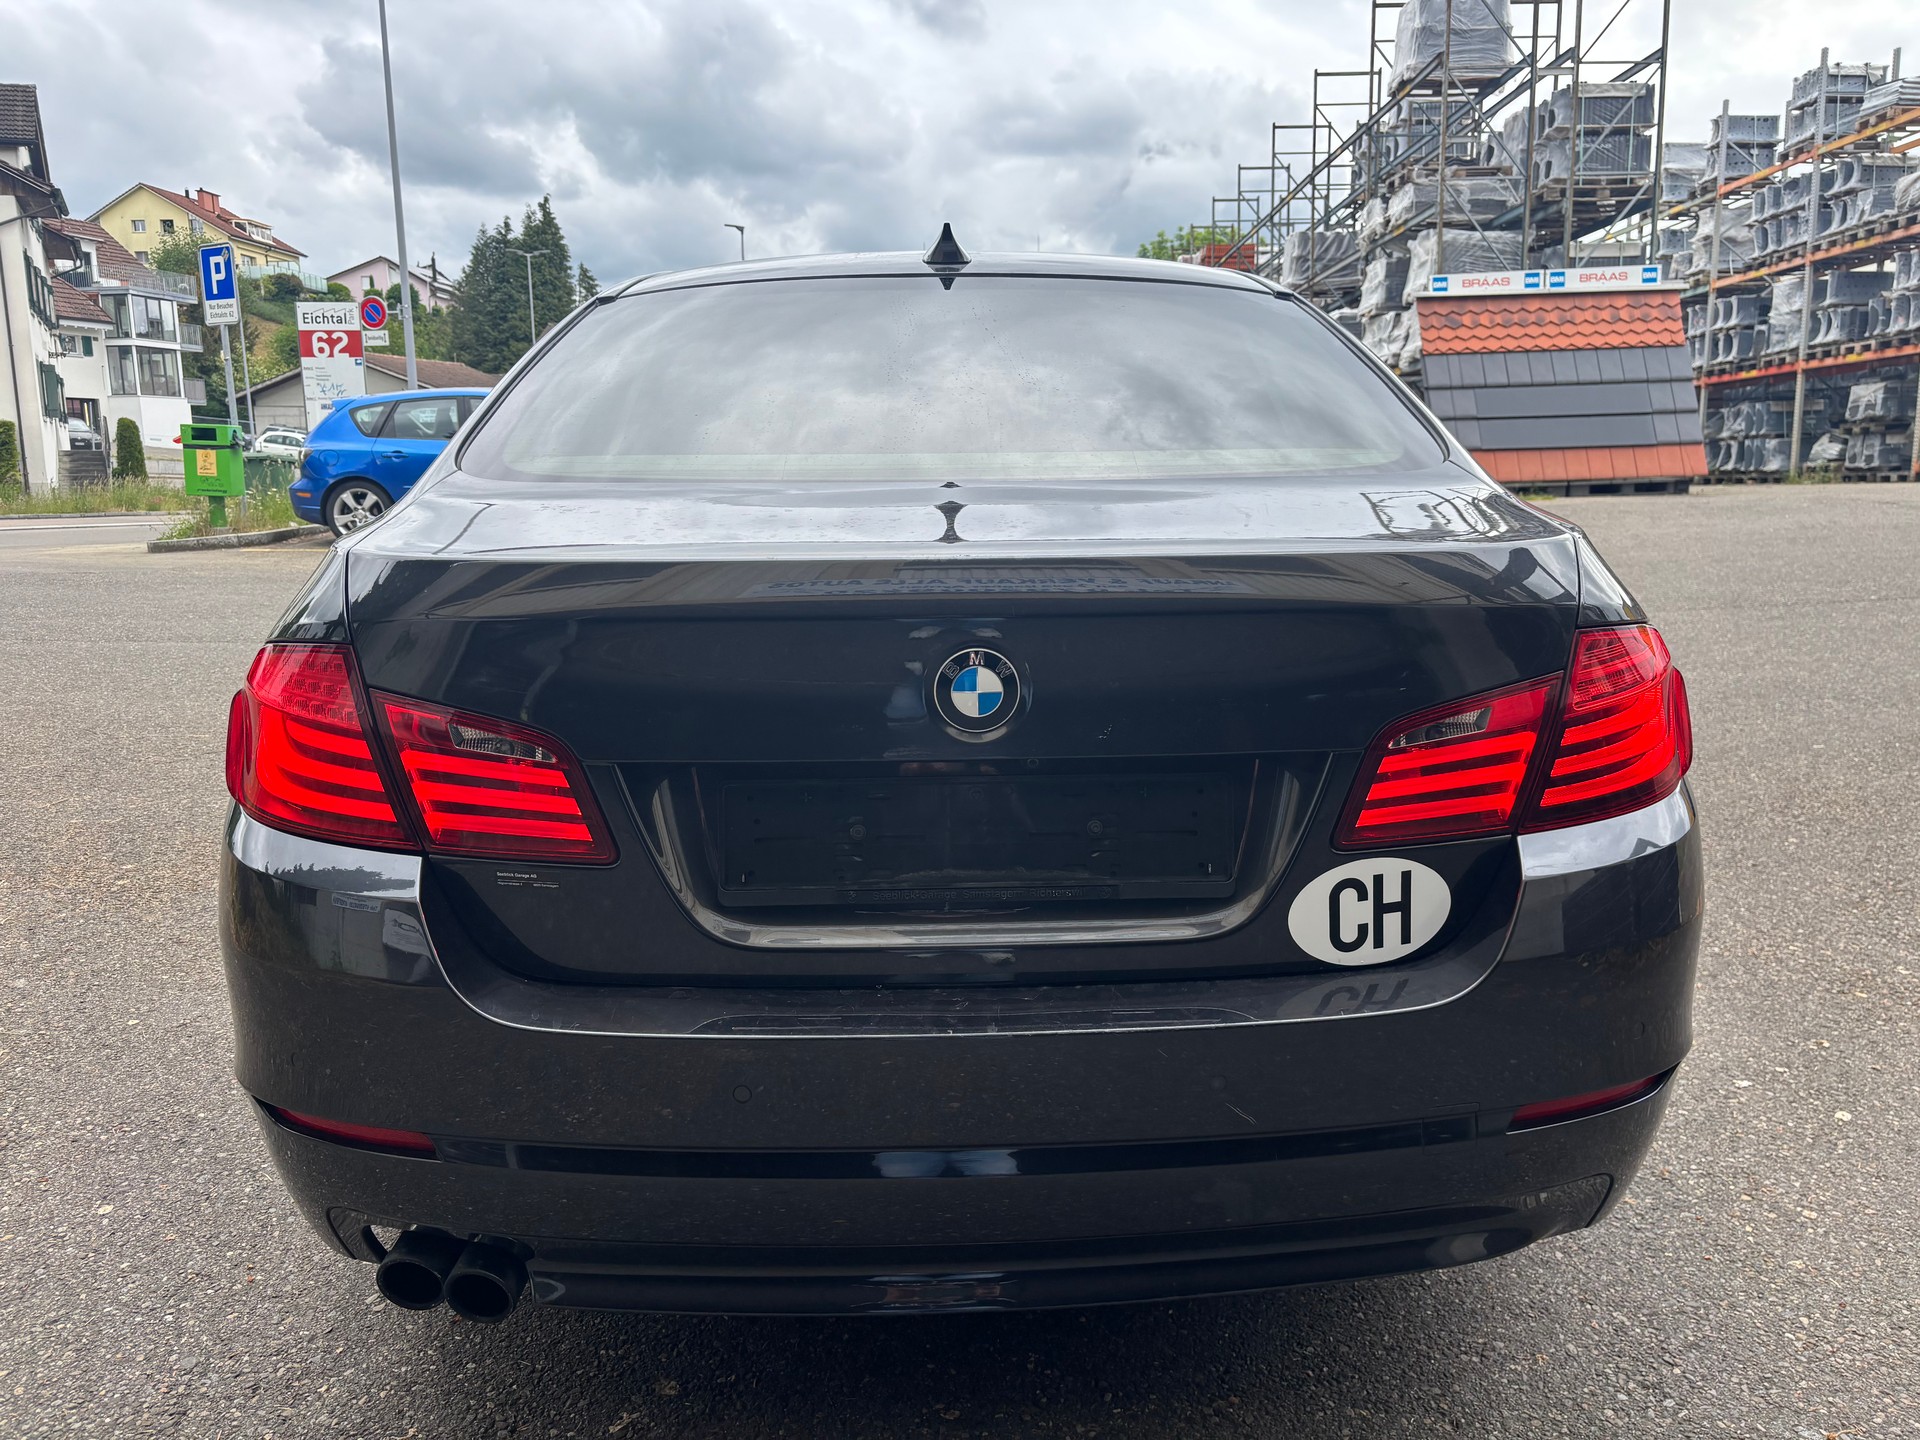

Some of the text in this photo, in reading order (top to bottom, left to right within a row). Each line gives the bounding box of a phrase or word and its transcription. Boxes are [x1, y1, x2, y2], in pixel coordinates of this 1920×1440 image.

[209, 255, 226, 295] P
[1462, 276, 1510, 288] BRAAS
[1579, 271, 1628, 283] BRAAS
[216, 302, 234, 310] Besucher
[228, 310, 234, 318] 62
[302, 311, 347, 325] Eichtal
[311, 331, 350, 358] 62
[943, 651, 1013, 680] BMW
[1329, 870, 1412, 953] CH
